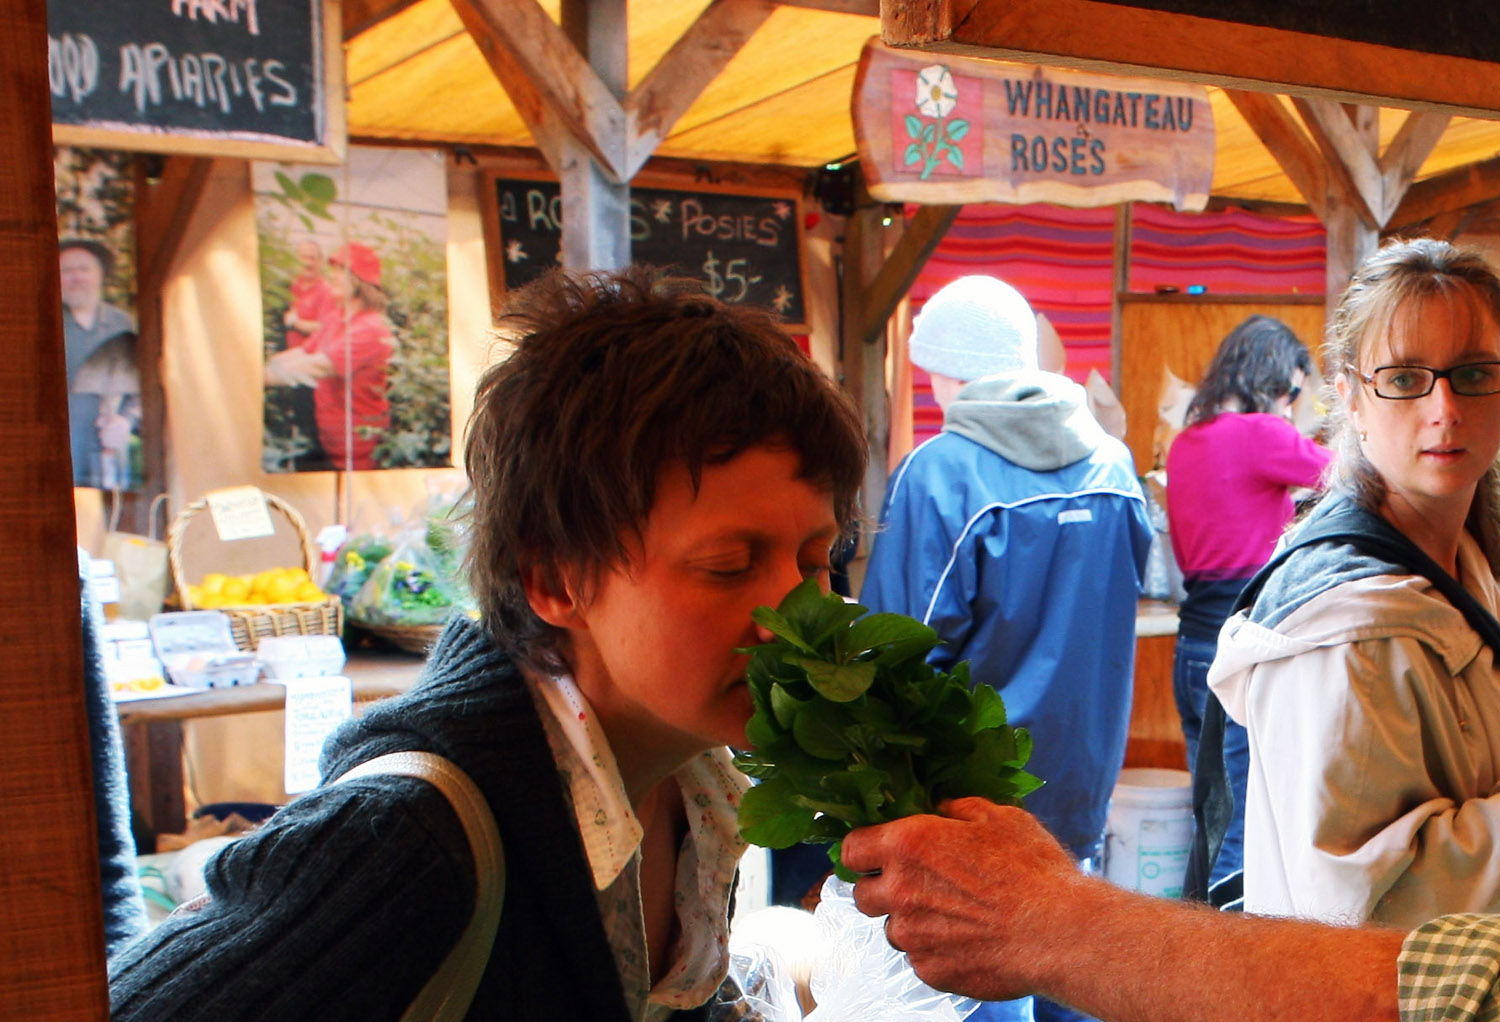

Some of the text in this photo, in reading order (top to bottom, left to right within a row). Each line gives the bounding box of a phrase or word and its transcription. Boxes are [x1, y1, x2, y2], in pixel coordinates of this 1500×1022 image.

[118, 42, 297, 114] APIARIES
[1004, 78, 1194, 132] WHANGATEAU
[1011, 133, 1106, 175] ROSES
[681, 199, 782, 248] POSIES
